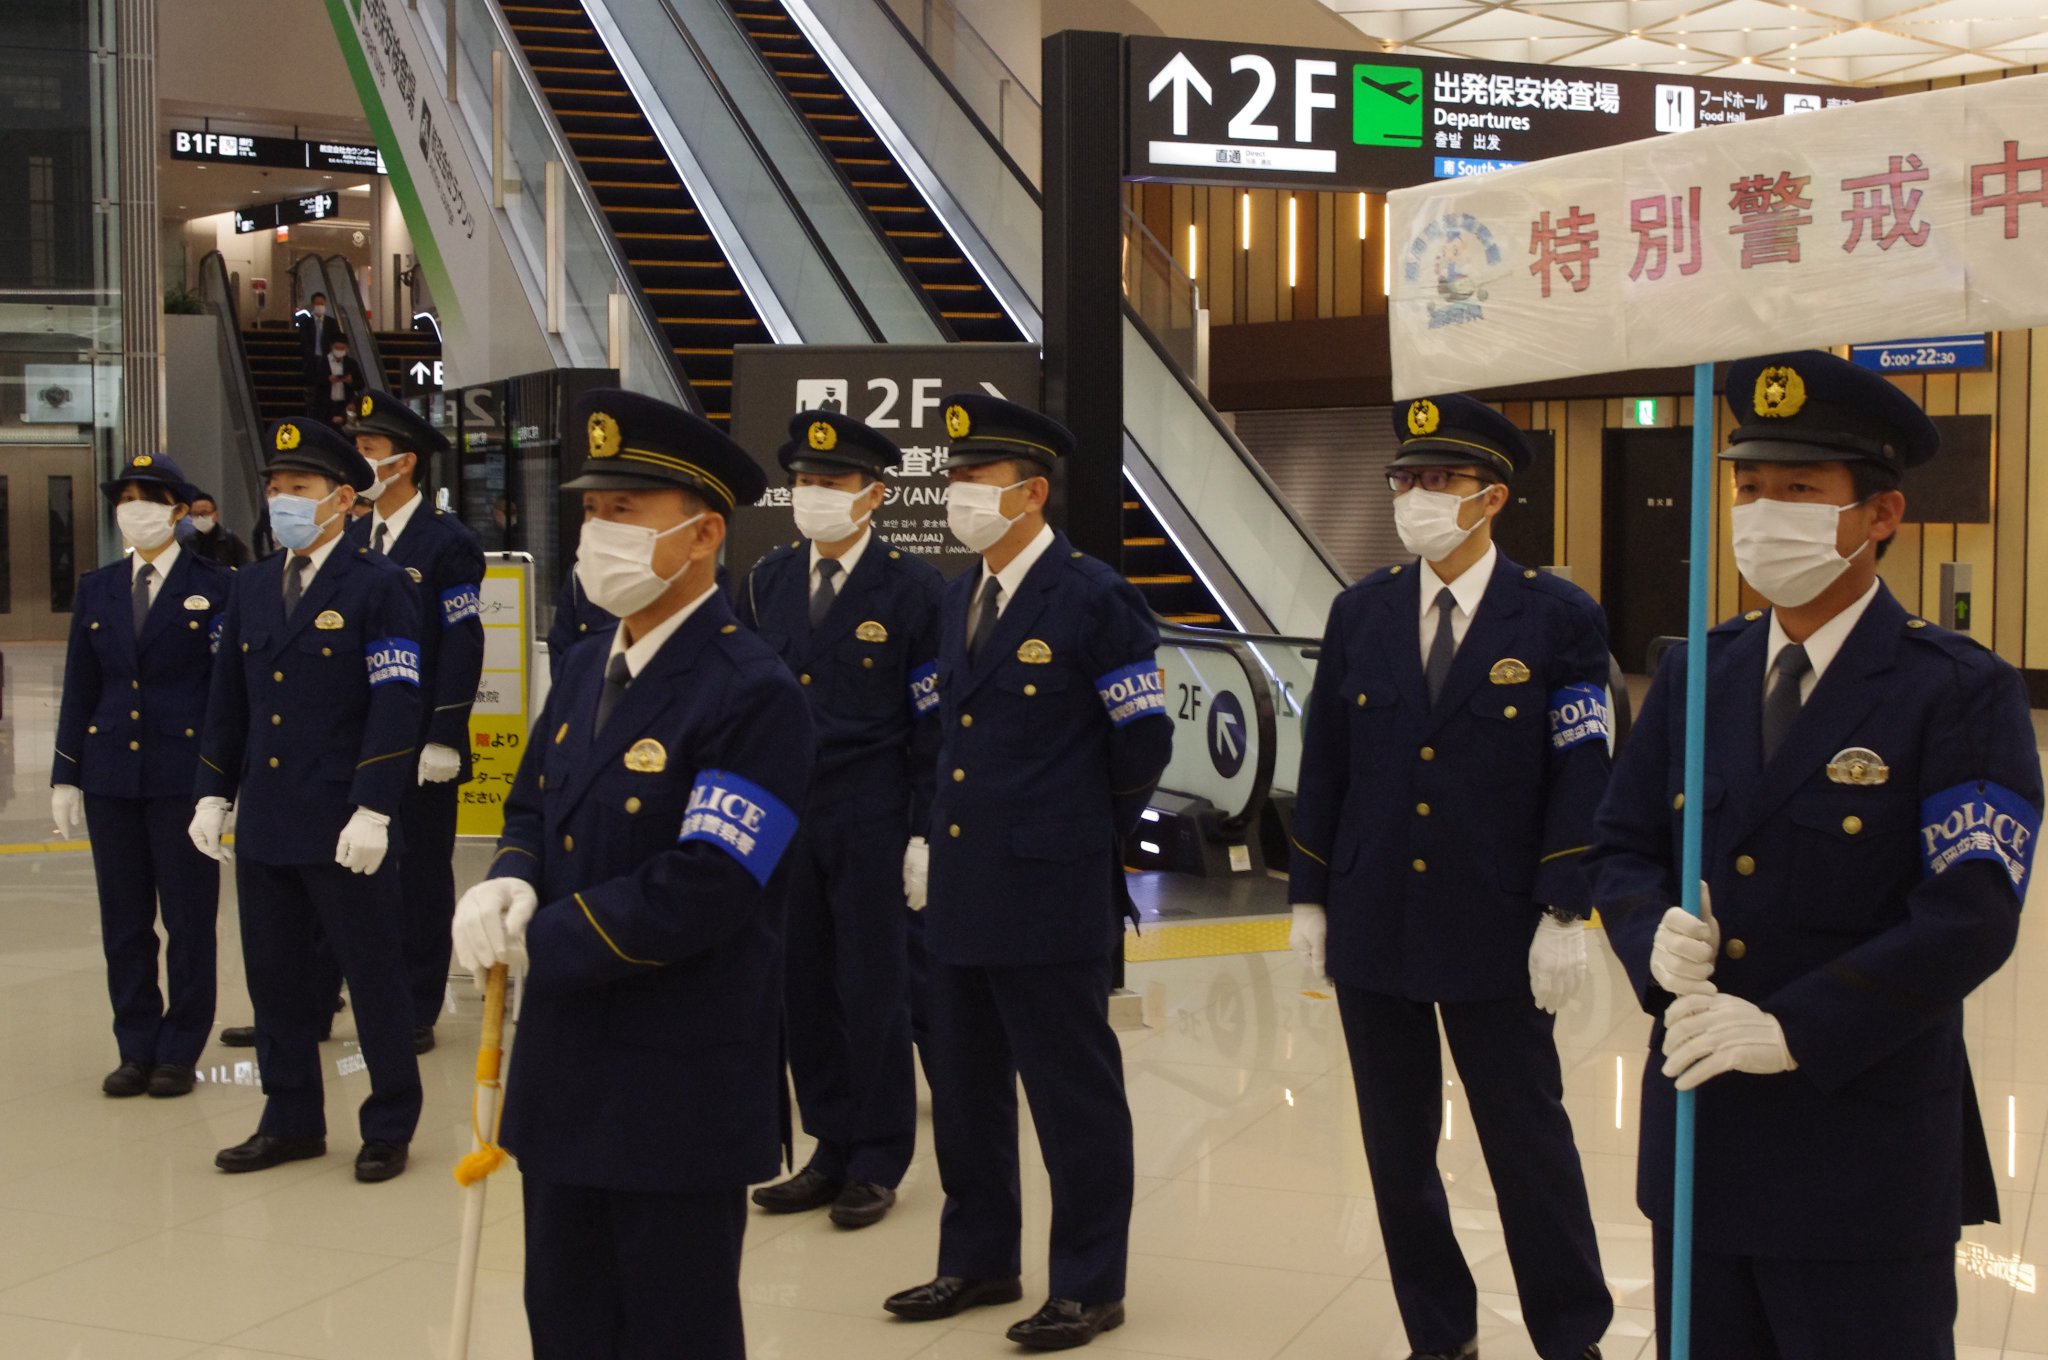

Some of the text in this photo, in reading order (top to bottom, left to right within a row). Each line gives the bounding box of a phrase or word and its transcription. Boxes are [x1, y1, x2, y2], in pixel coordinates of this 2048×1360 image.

[1228, 54, 1337, 143] 2F
[1434, 71, 1620, 114] 出発保安検査場
[1700, 90, 1768, 110] フードホール
[1433, 108, 1531, 131] Departures
[1700, 110, 1746, 122] Food Hall
[176, 132, 218, 154] B1F
[1434, 131, 1463, 149] 출발
[1216, 149, 1241, 164] 直通
[1457, 160, 1496, 176] South
[1528, 140, 2048, 298] 特別警戒中
[865, 378, 943, 428] 2F
[365, 649, 418, 671] POLICE
[1178, 682, 1202, 721] 2F
[457, 792, 502, 804] ださい
[1921, 802, 2031, 858] POLICE
